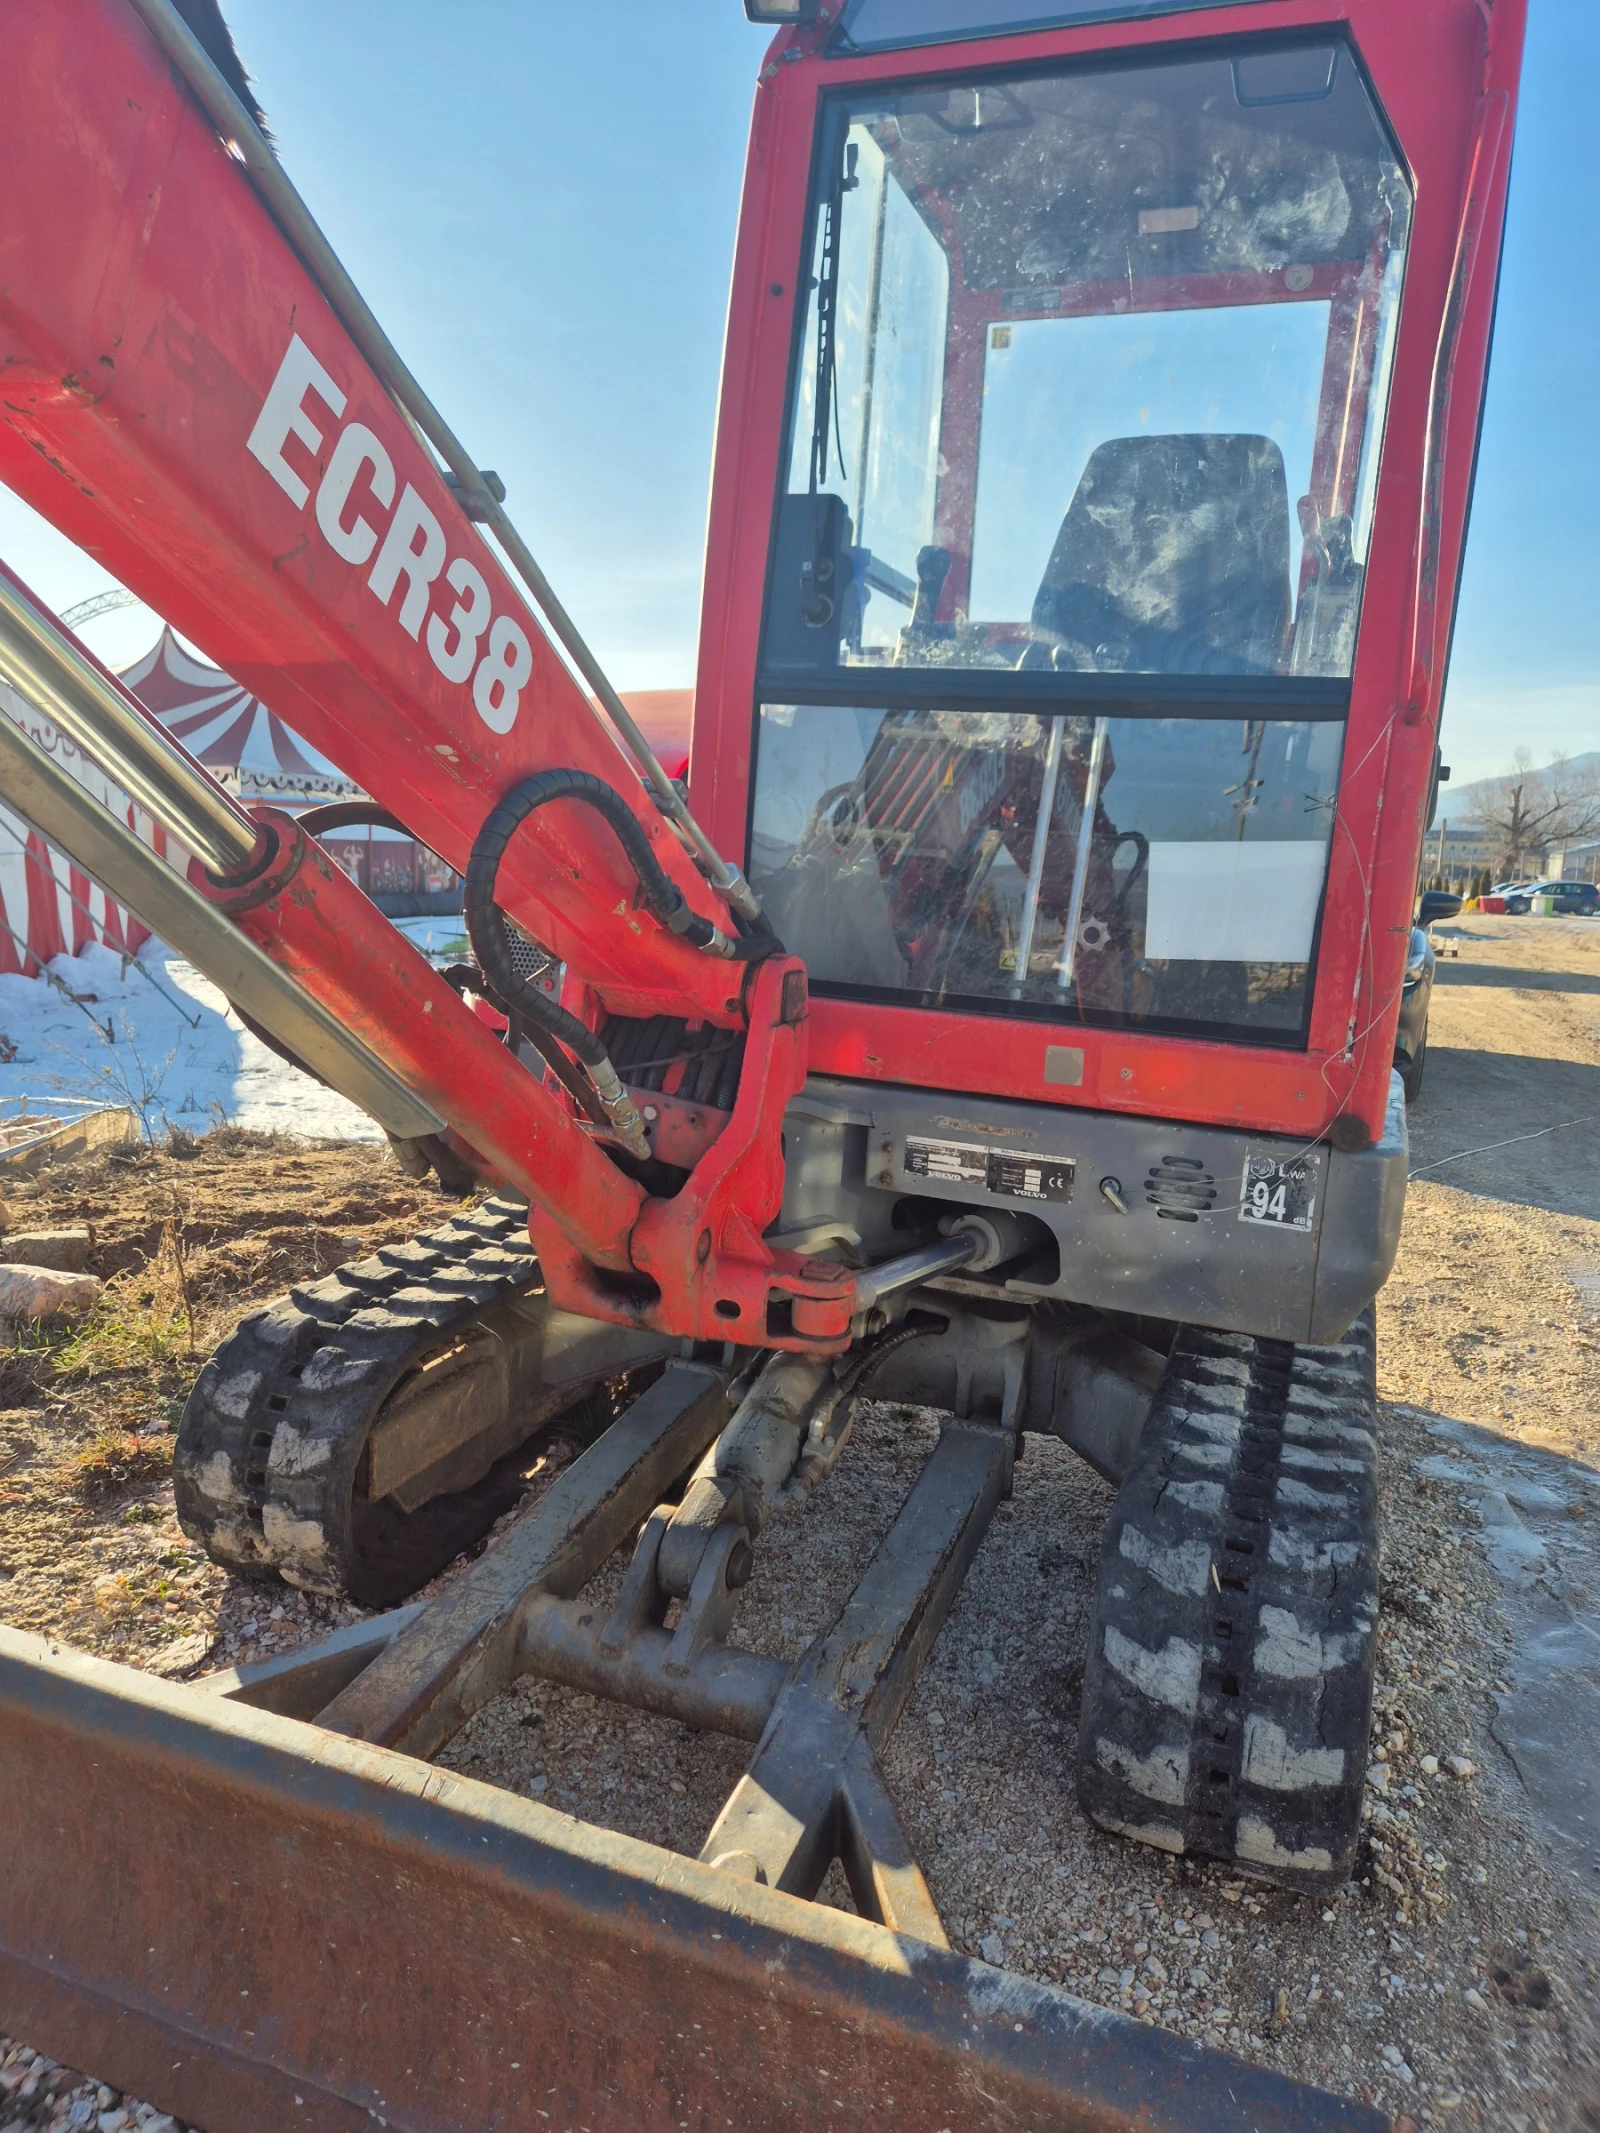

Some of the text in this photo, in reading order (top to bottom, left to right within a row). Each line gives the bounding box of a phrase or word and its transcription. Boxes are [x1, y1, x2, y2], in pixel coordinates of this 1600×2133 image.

[246, 332, 532, 735] ECR38
[927, 1171, 962, 1182] VOLVO
[1012, 1188, 1048, 1199] VOLVO
[1252, 1181, 1286, 1221] 94
[1292, 1216, 1307, 1225] dB
